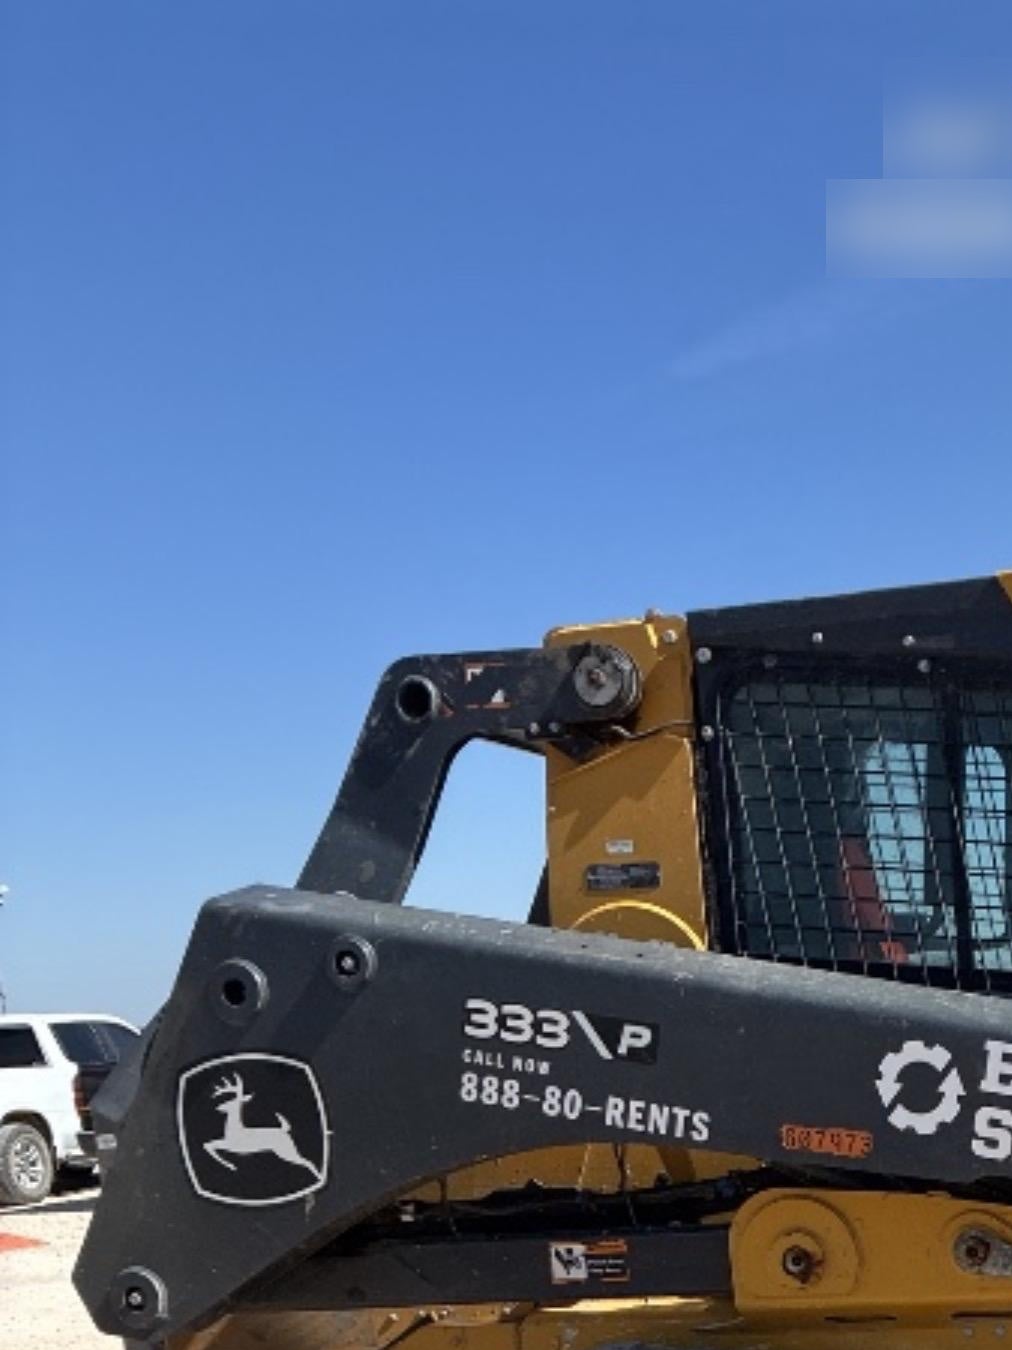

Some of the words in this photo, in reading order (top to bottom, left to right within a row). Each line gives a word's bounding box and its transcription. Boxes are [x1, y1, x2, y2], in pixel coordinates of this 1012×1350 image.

[462, 1048, 505, 1070] CALL
[512, 1055, 551, 1076] NOW
[460, 1071, 712, 1142] 888-80-RENTS
